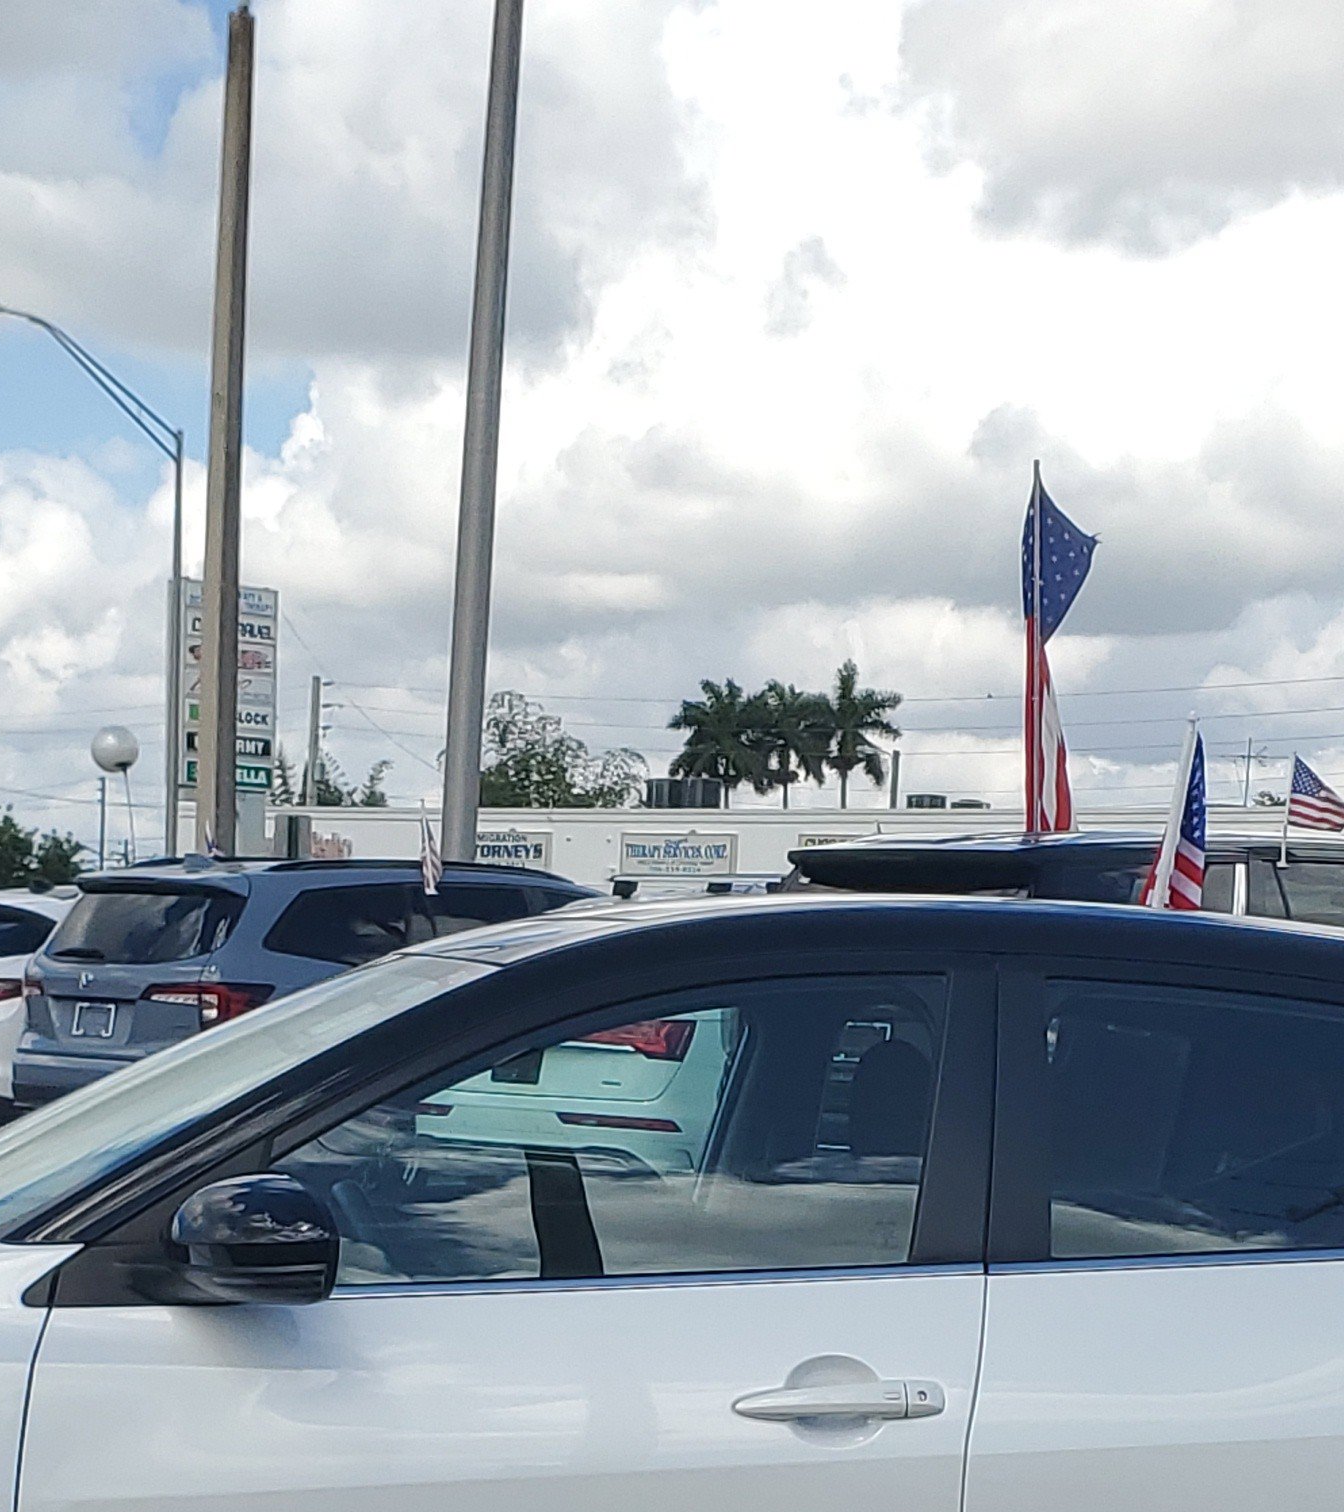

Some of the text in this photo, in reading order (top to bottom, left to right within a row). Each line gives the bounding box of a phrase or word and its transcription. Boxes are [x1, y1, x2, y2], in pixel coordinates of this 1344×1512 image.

[236, 711, 268, 726] LOCK
[236, 739, 265, 756] RMY
[236, 768, 268, 785] ELLA
[476, 833, 528, 843] MIGRATION
[476, 843, 543, 859] ORNEYS
